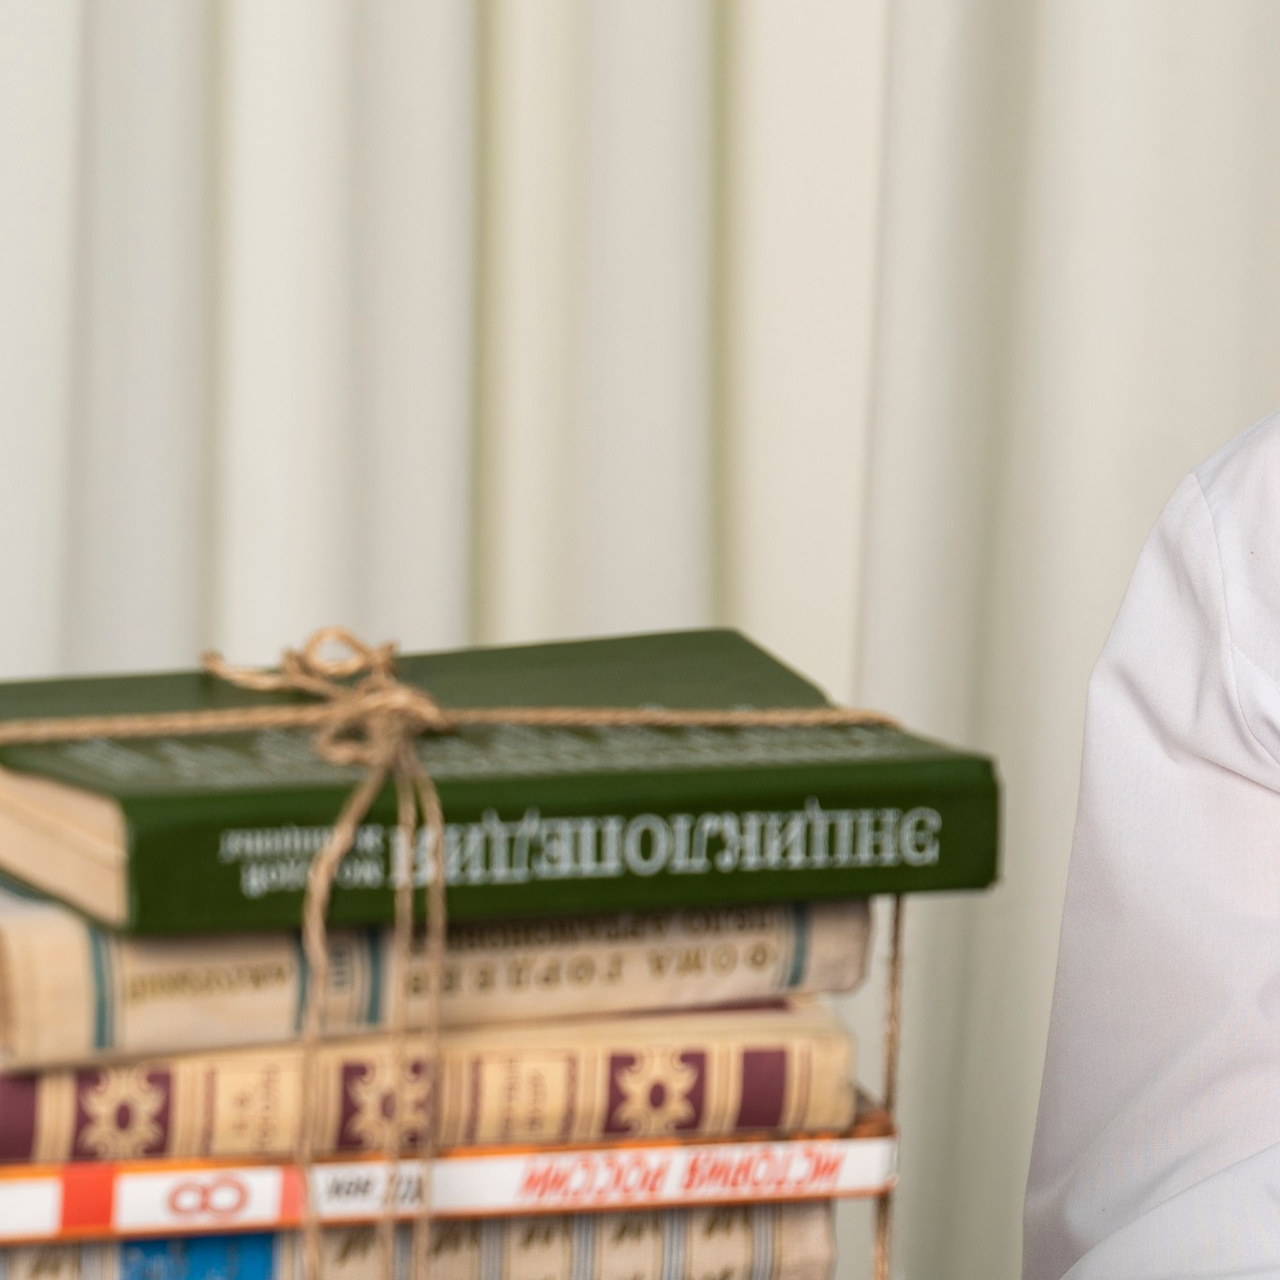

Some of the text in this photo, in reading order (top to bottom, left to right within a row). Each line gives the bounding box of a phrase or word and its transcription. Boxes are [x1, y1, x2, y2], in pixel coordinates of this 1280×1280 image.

[390, 797, 941, 888] ЭНЦИКЛОПЕДИЯ
[516, 1155, 672, 1206] РОССИИ
[680, 1147, 846, 1197] ИСТОРИЯ
